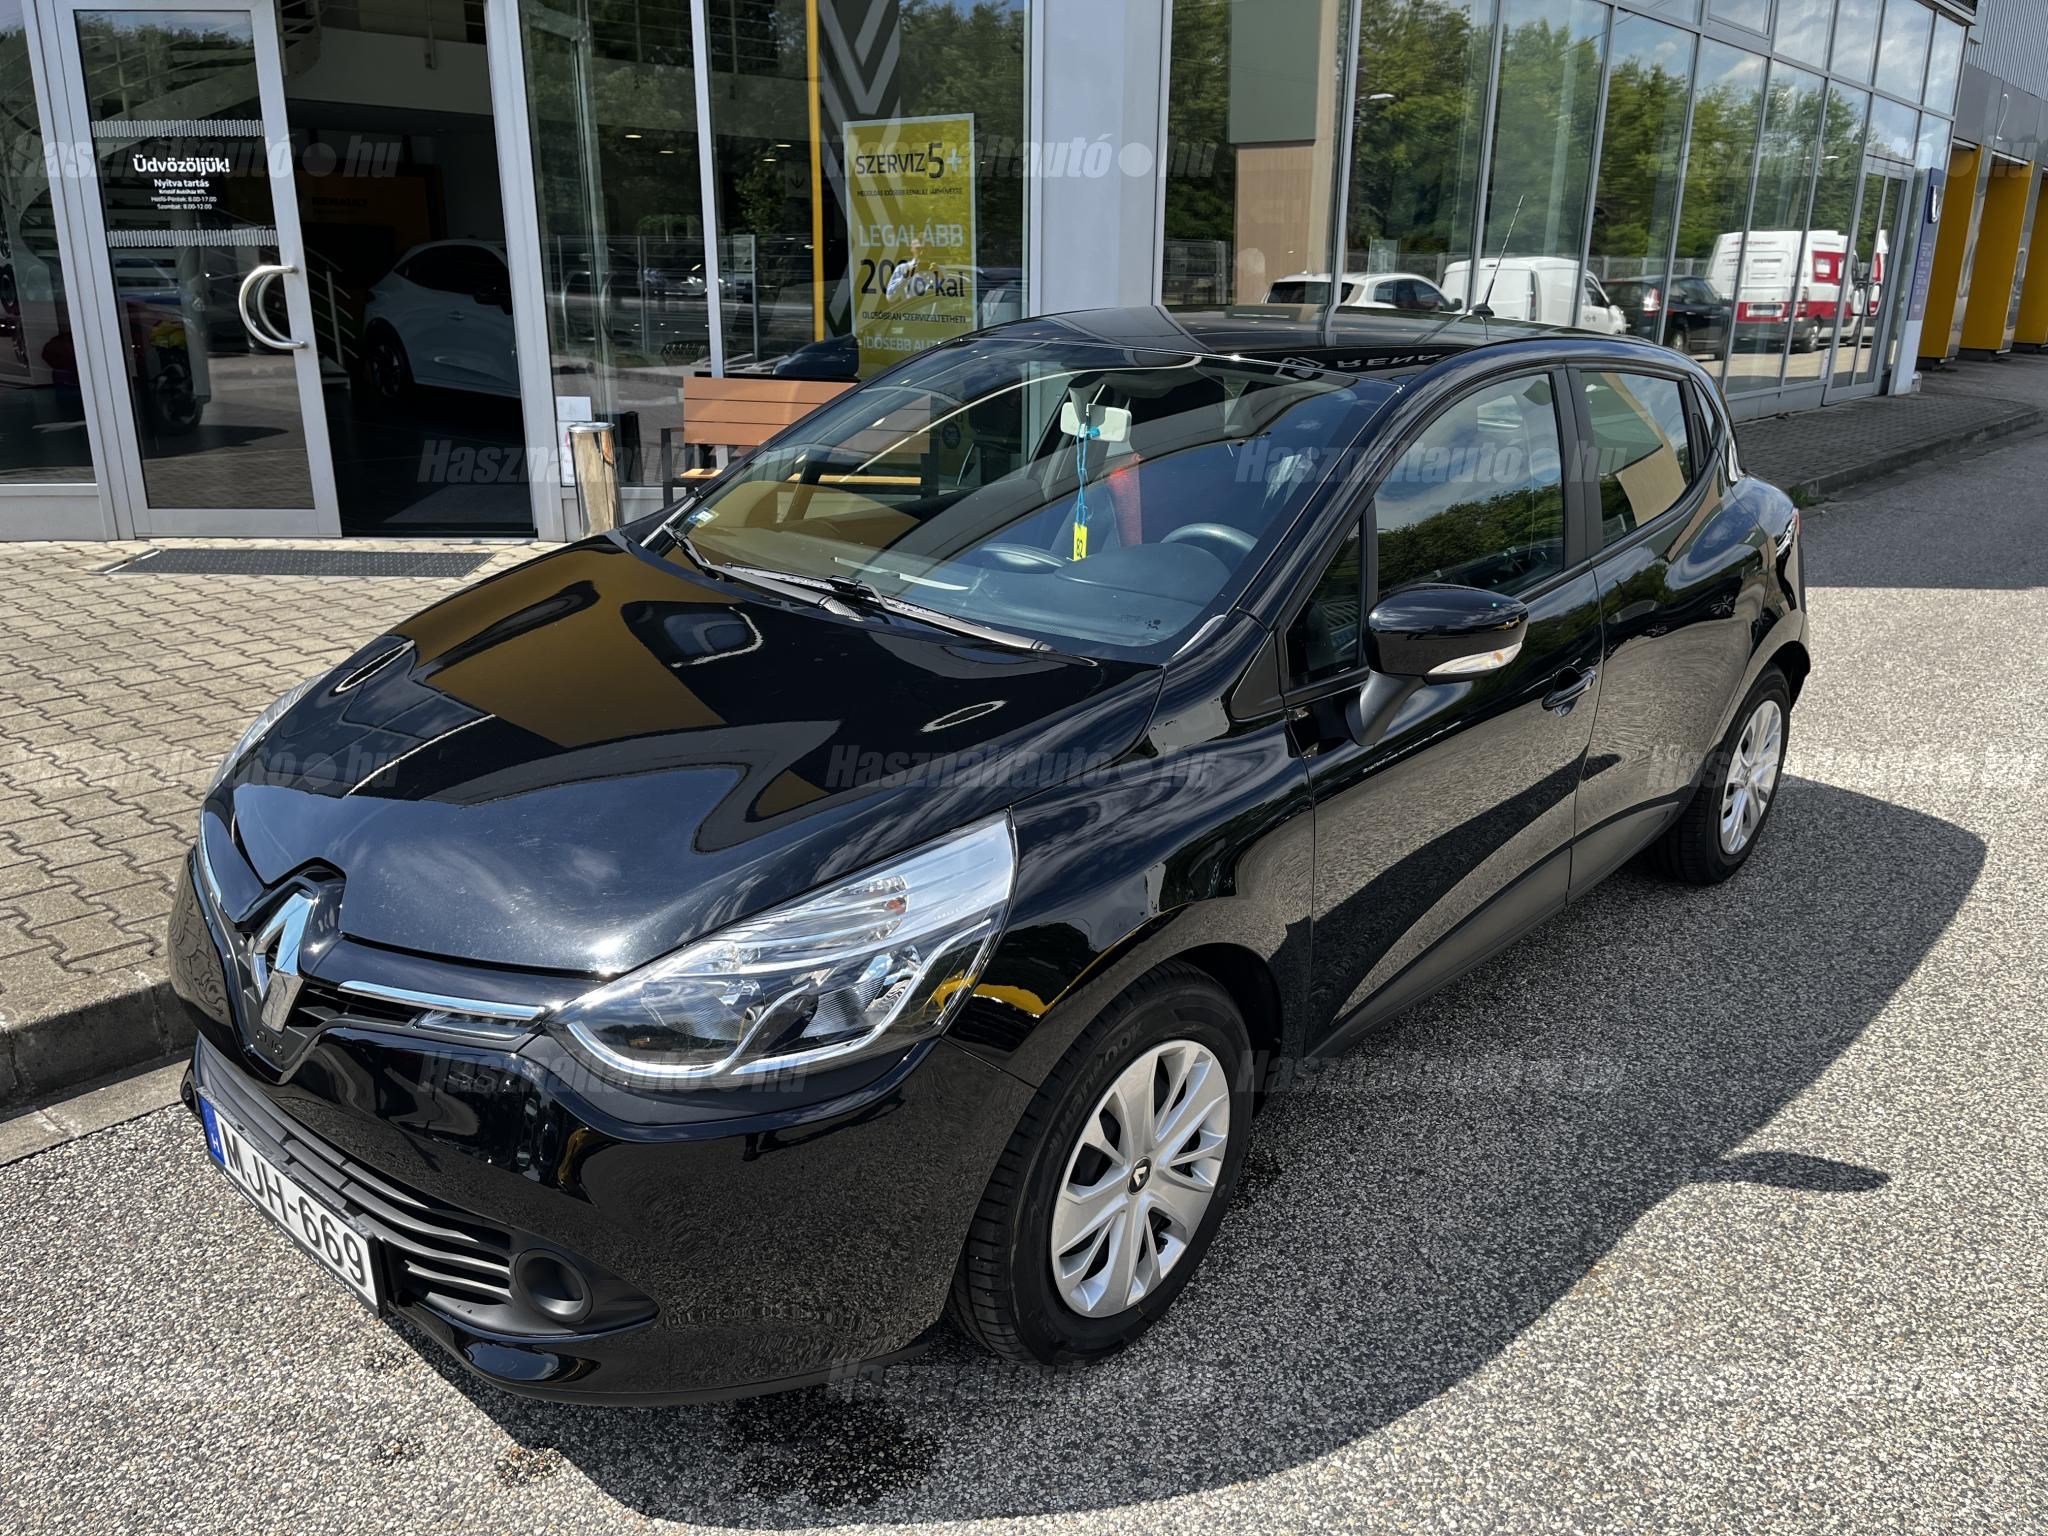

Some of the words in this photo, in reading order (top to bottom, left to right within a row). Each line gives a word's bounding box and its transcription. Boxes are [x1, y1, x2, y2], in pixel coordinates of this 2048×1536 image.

[133, 154, 230, 176] Üdvözöljük!
[855, 153, 926, 175] SZERVIZ
[154, 179, 183, 189] Nyitva
[183, 179, 210, 188] tartás
[858, 218, 964, 247] LEGALÁBB
[210, 1132, 221, 1155] H
[220, 1122, 368, 1289] MJH-669
